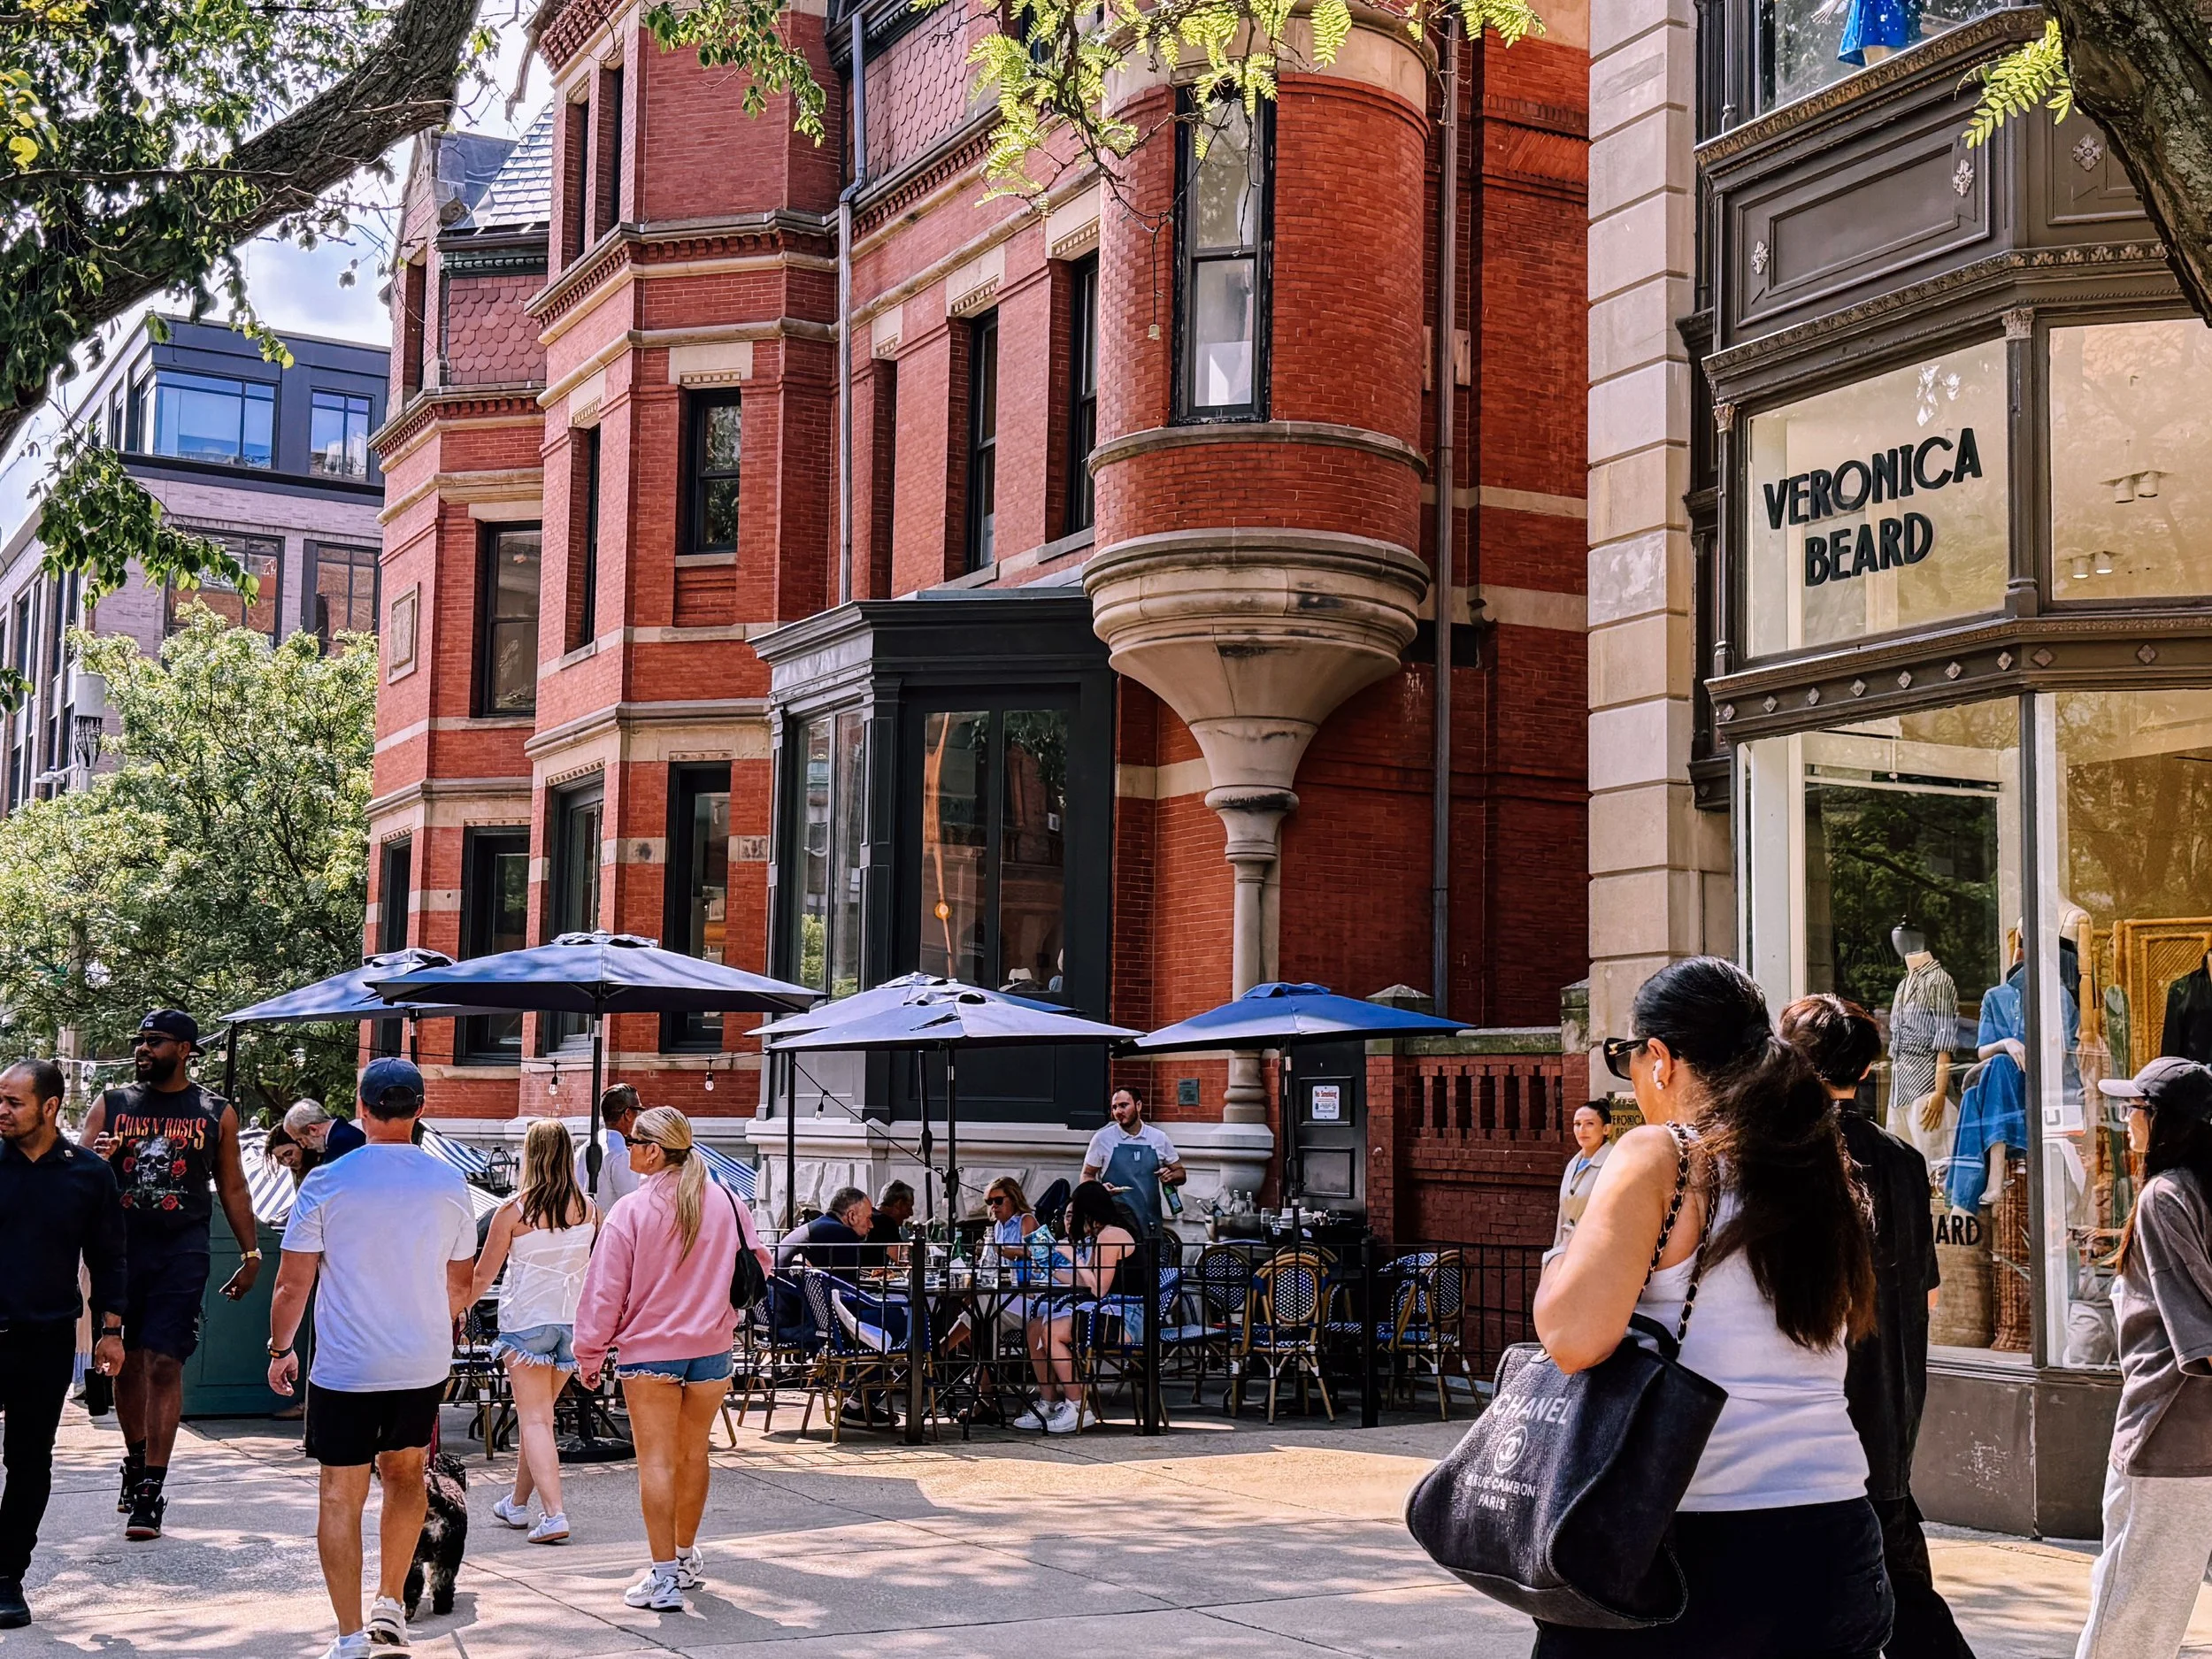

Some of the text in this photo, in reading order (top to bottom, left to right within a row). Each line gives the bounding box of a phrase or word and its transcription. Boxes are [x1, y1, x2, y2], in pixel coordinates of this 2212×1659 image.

[1763, 428, 1982, 529] VERONICA
[1805, 512, 1933, 587] BEARD
[165, 1118, 207, 1149] ROSES
[1934, 1215, 1982, 1246] ARD
[1493, 1394, 1572, 1425] CHANEL
[1478, 1494, 1507, 1510] PARIS
[1492, 1477, 1536, 1498] CAMBON
